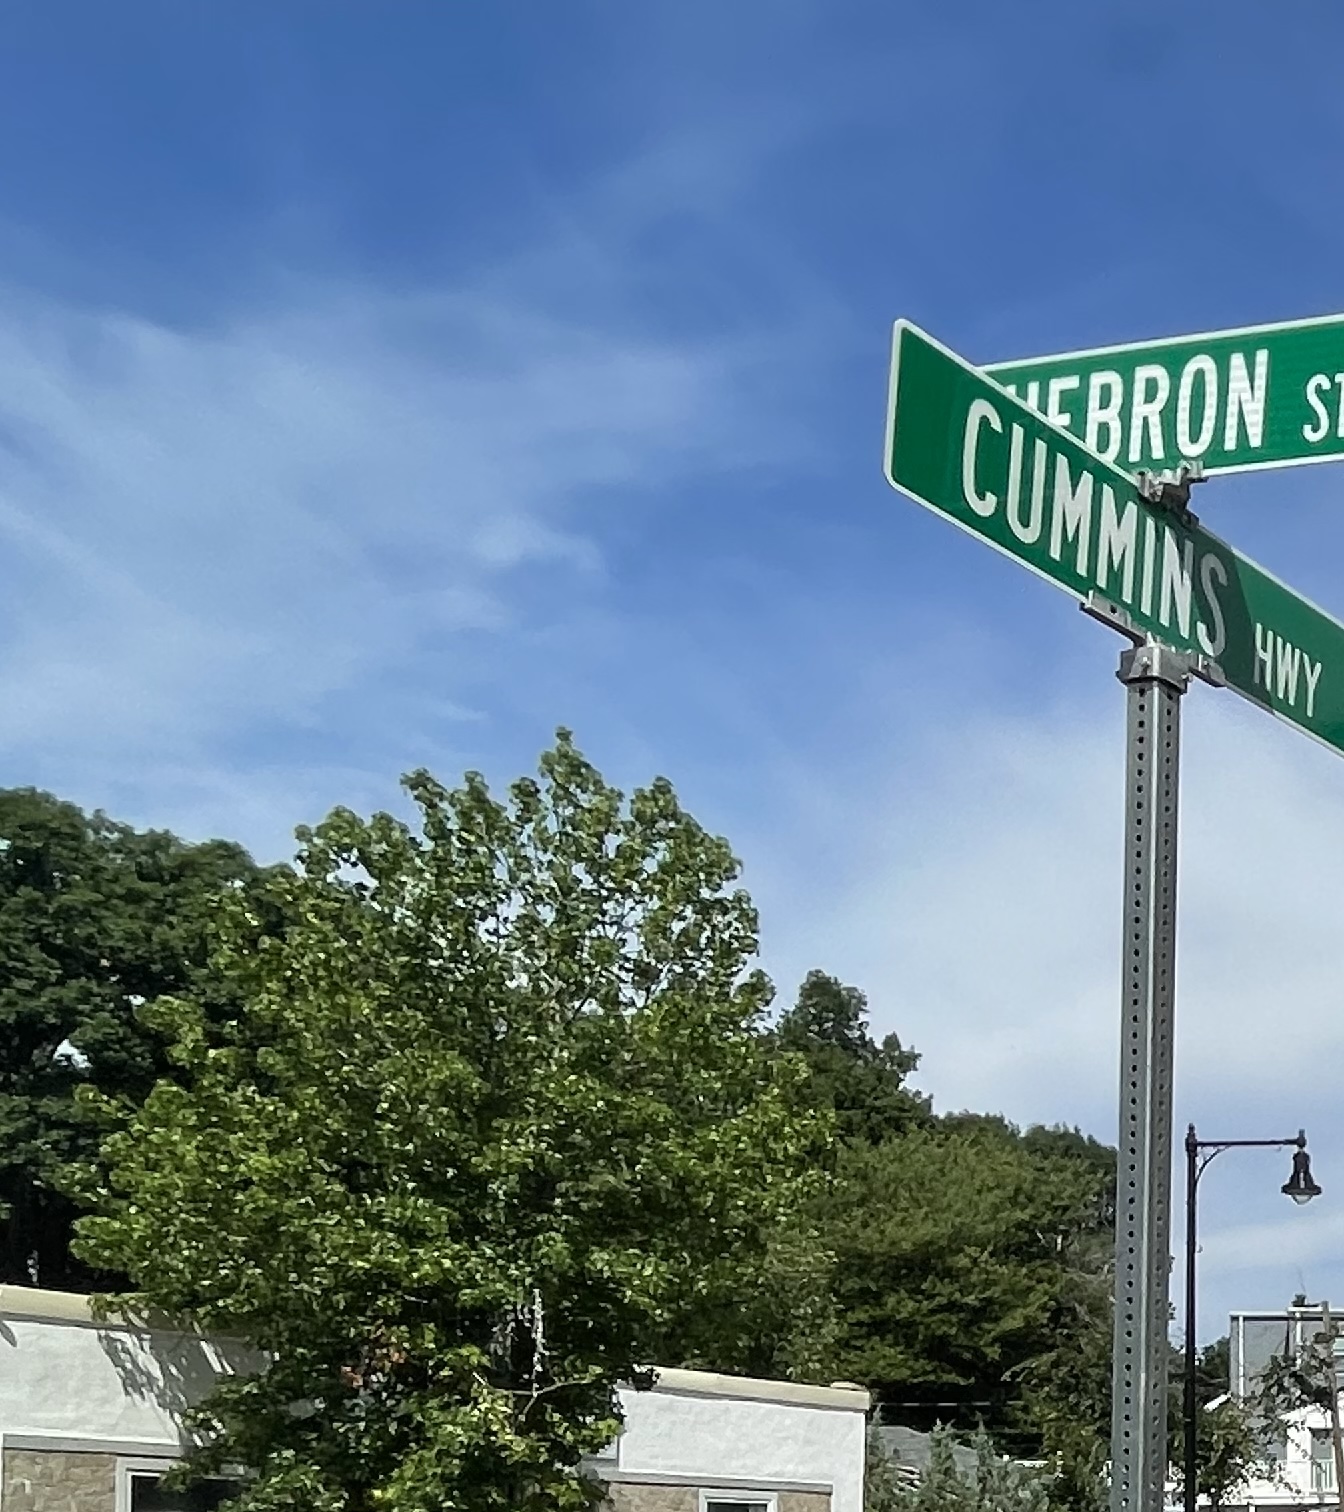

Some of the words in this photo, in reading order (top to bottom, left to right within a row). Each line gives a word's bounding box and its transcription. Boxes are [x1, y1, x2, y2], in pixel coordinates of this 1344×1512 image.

[1006, 349, 1269, 466] EBRON
[962, 398, 1228, 657] CUMMINS
[1253, 622, 1322, 717] HWY
